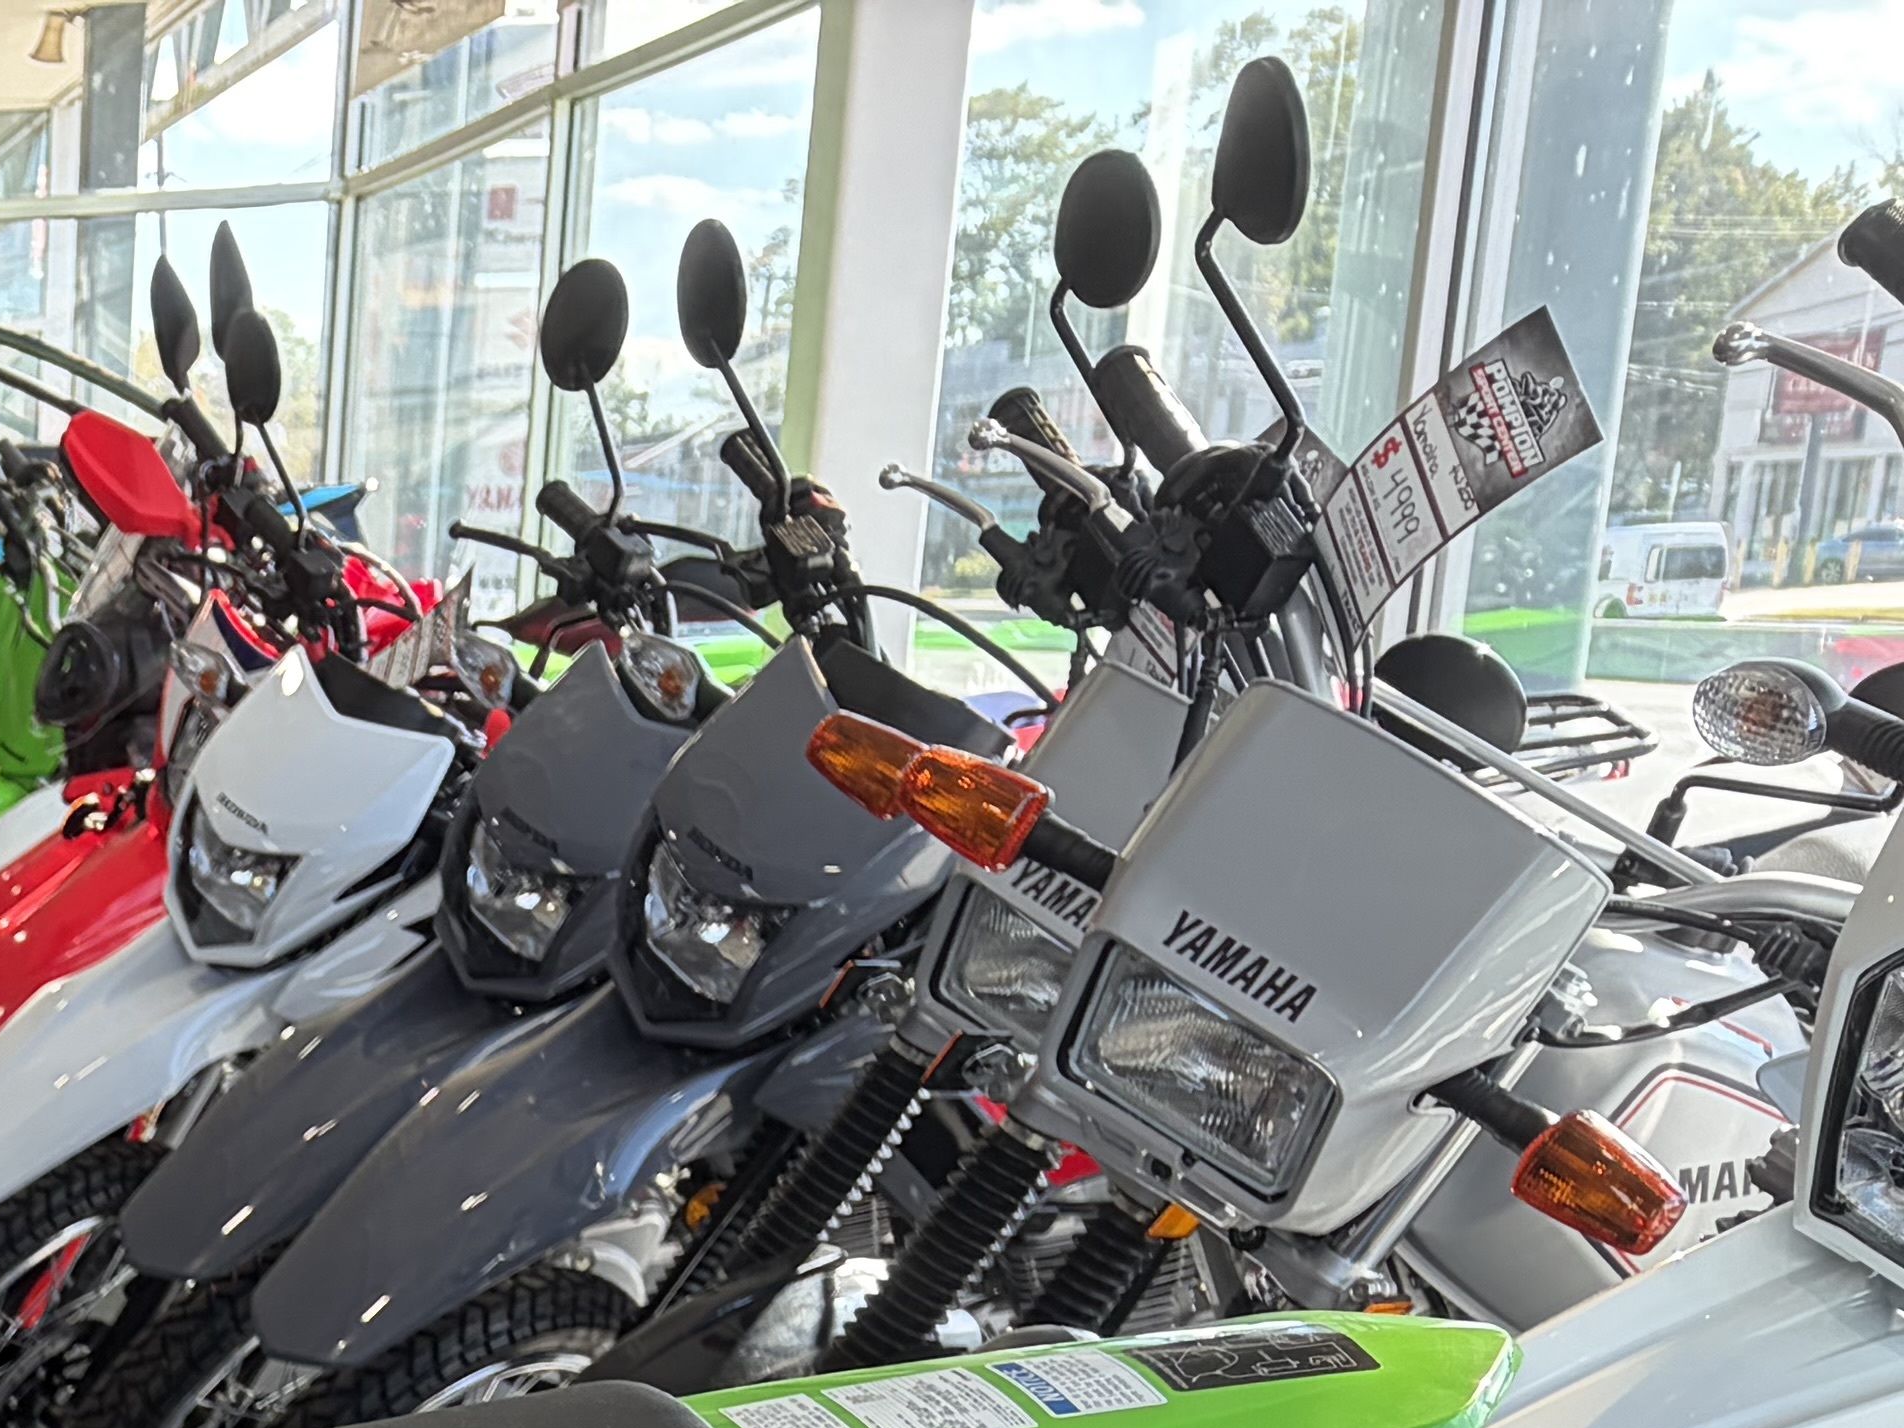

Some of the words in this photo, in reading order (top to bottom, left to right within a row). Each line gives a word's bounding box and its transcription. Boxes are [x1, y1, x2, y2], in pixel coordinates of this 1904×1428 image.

[1484, 361, 1545, 468] POMPTON
[1010, 857, 1101, 931] YAMA
[1162, 909, 1318, 1024] YAMAHA
[1003, 1368, 1067, 1402] NOTICE
